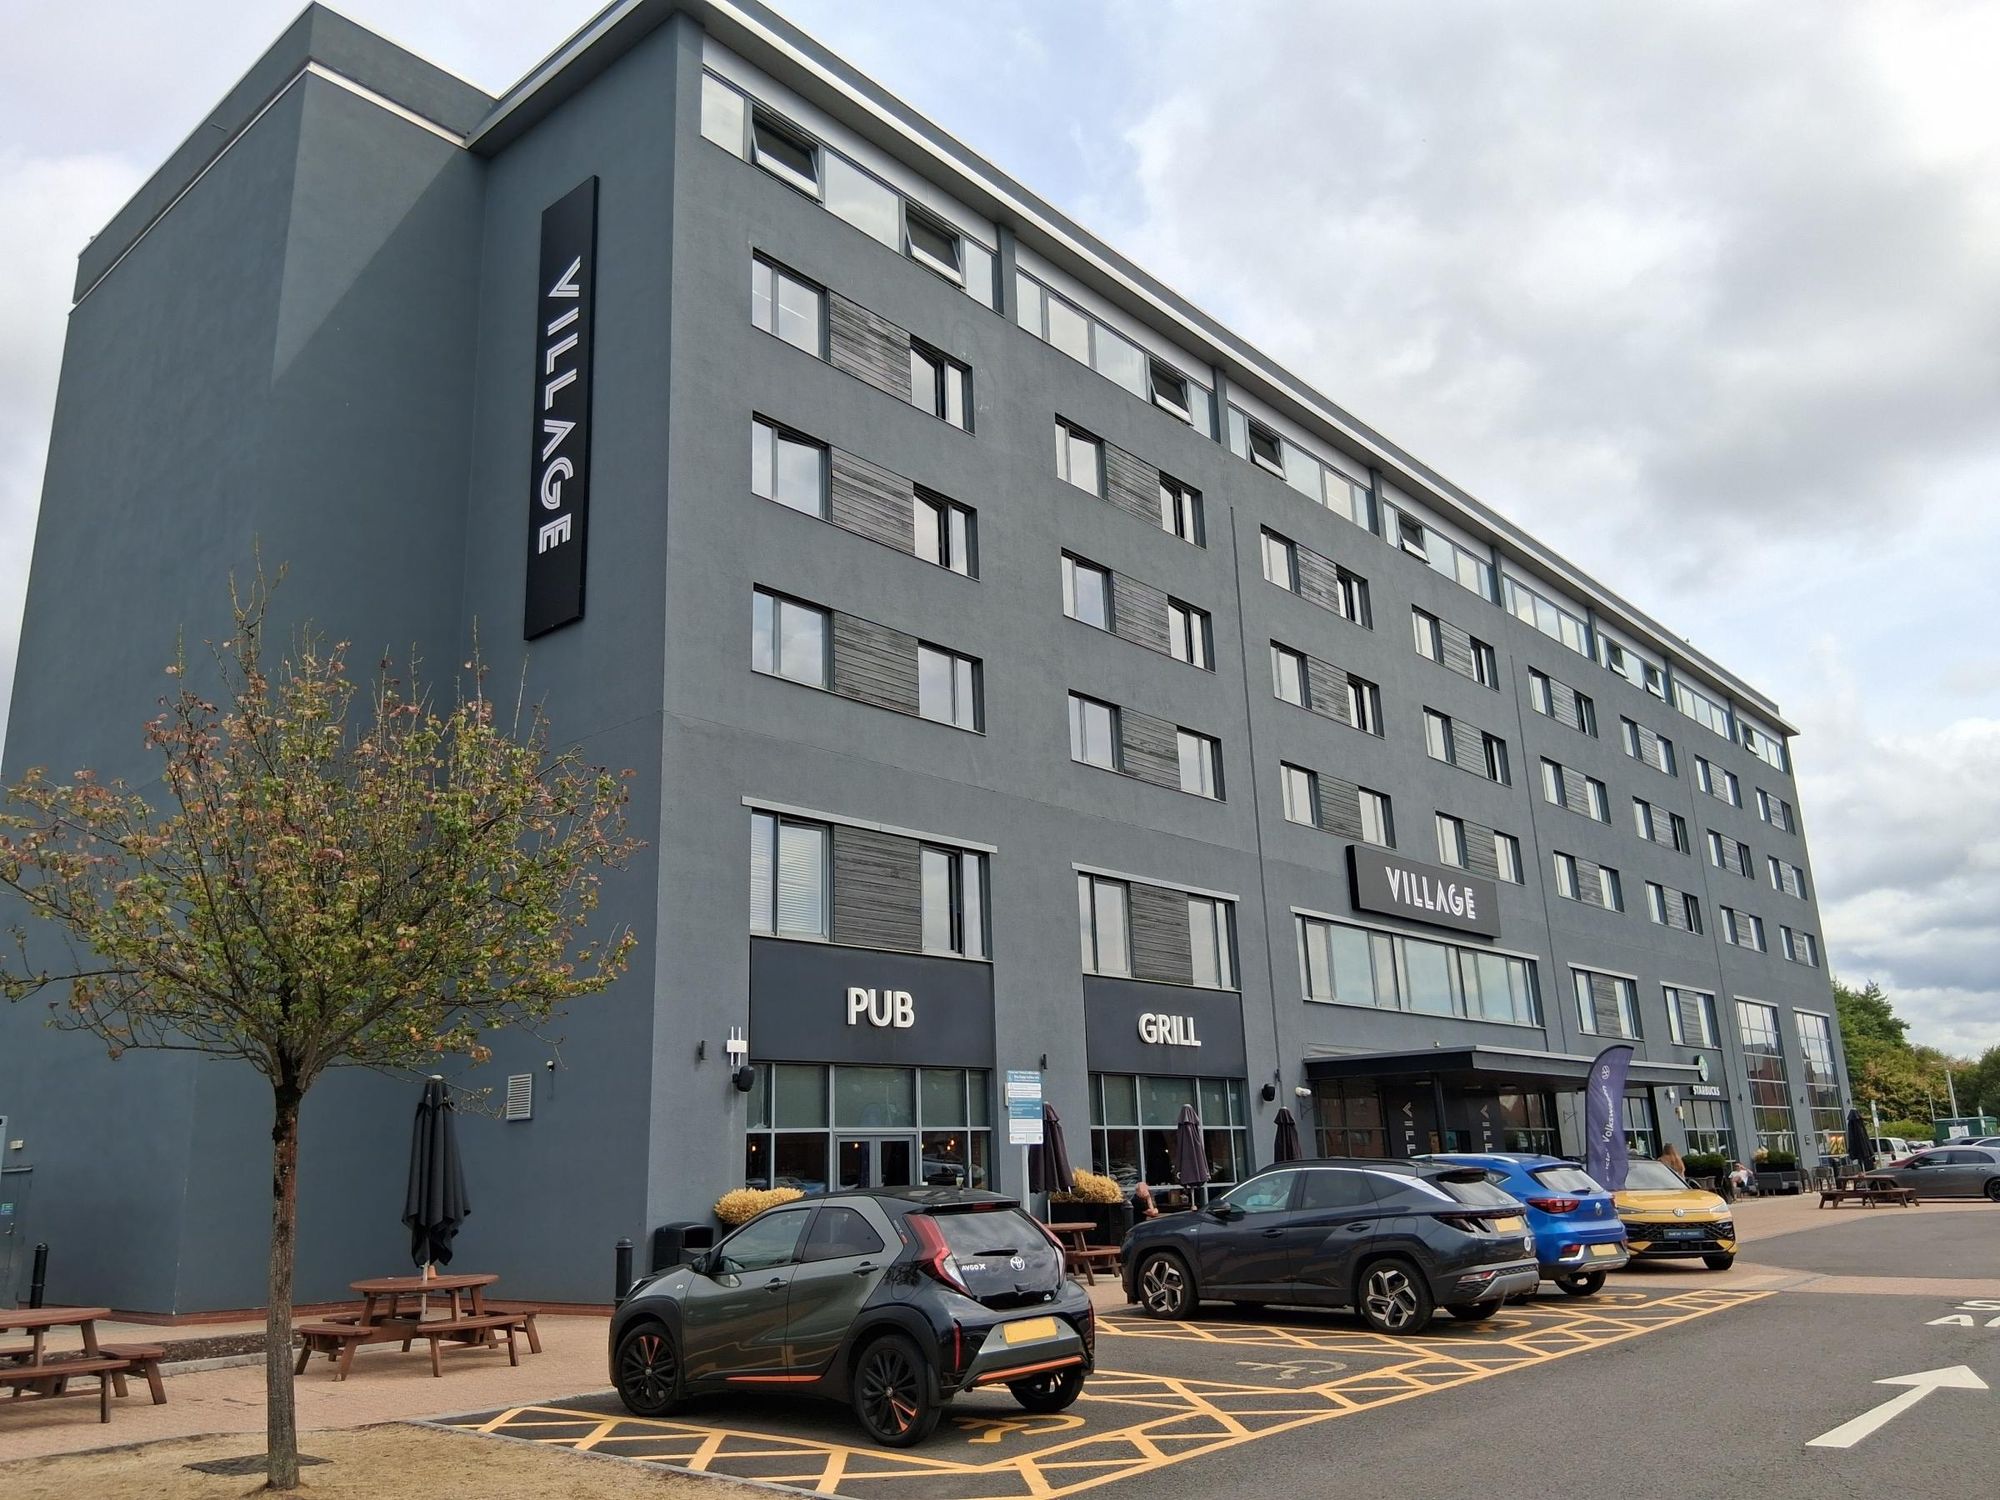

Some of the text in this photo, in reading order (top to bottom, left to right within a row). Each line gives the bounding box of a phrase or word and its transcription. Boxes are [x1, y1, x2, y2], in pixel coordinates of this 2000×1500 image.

[538, 255, 582, 555] VILLAGE
[1385, 866, 1477, 920] VILLAGE
[847, 986, 915, 1029] PUB
[1138, 1012, 1202, 1047] GRILL
[1402, 1101, 1416, 1154] VILL
[1480, 1104, 1493, 1153] VILL
